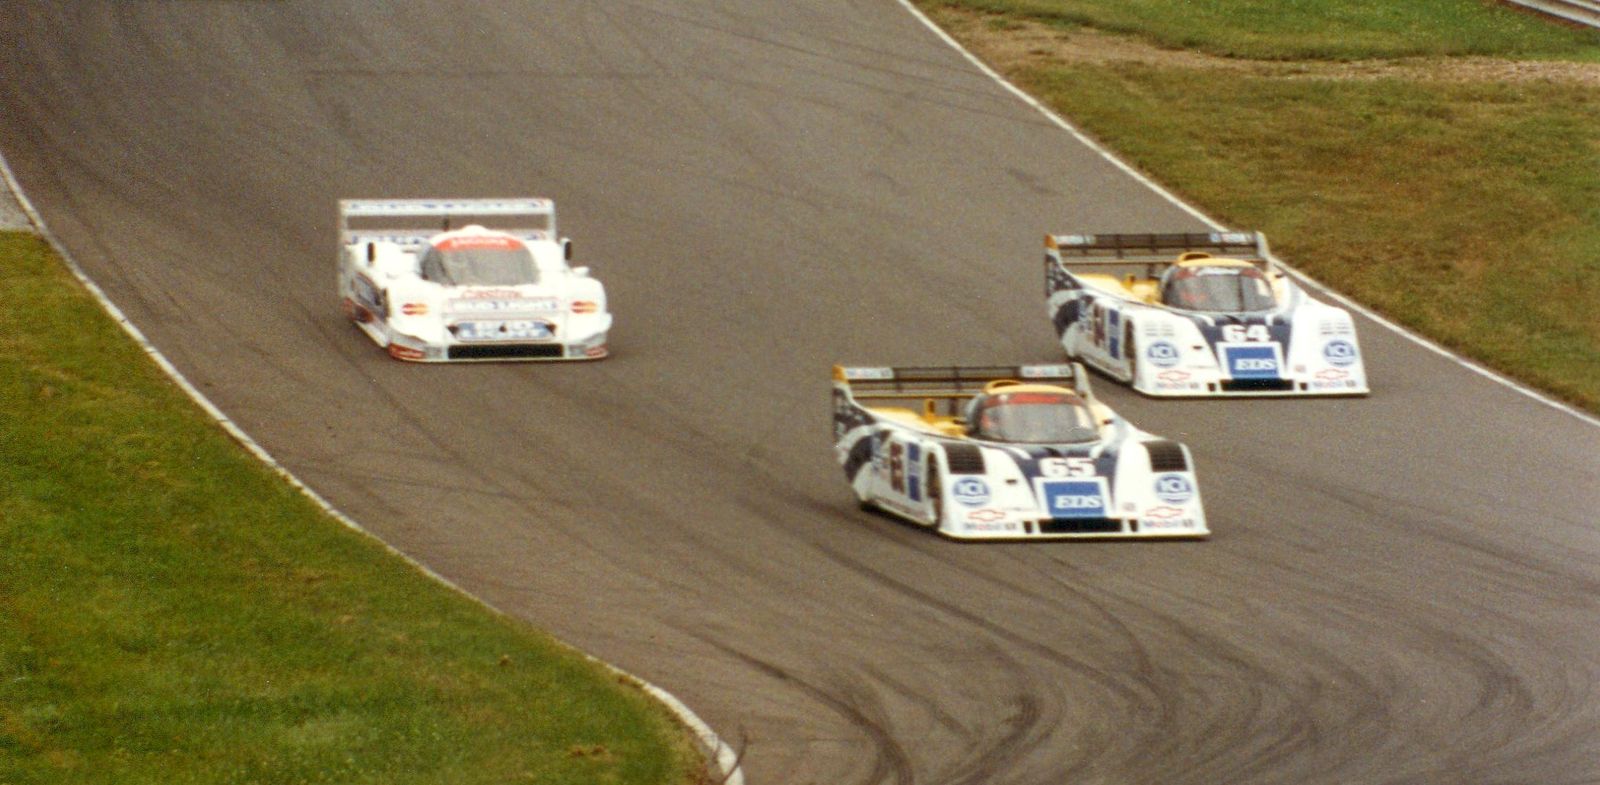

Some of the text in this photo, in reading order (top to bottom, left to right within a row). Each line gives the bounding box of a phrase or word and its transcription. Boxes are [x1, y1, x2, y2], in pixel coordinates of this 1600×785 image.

[1222, 324, 1271, 343] 64
[1233, 358, 1278, 371] EDS
[1039, 457, 1097, 477] 65
[1054, 495, 1103, 508] EDS
